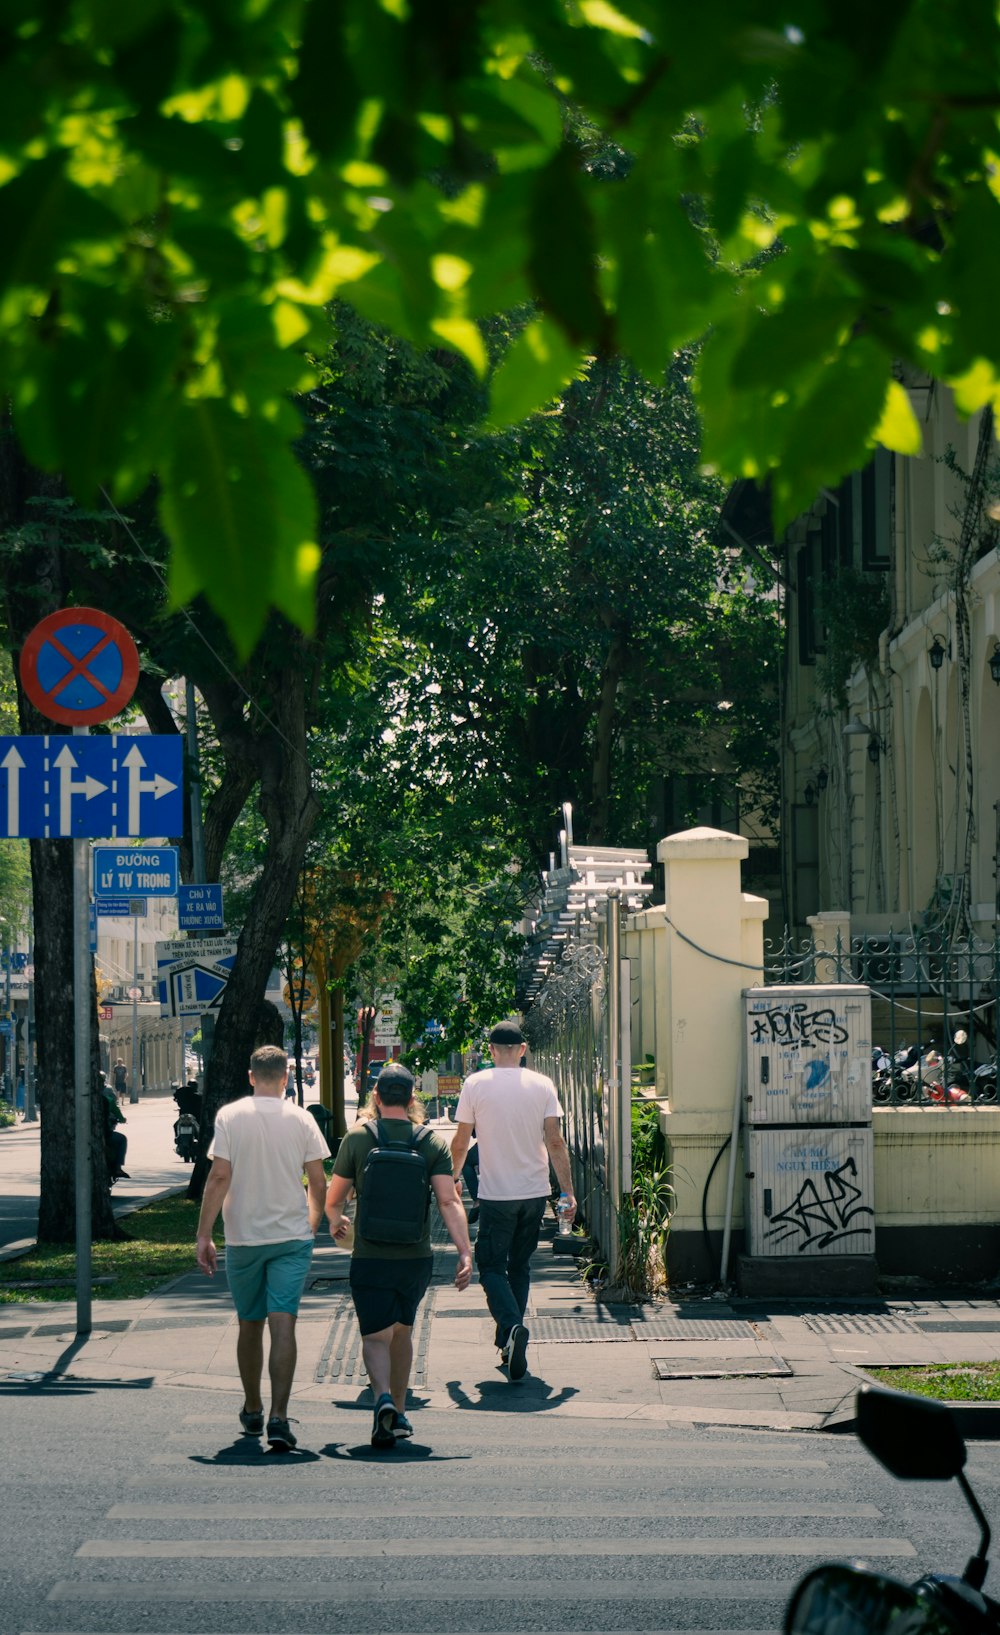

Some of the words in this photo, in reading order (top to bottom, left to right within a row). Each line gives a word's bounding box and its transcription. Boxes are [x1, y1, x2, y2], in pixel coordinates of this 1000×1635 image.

[116, 853, 160, 866] ĐƯỜNG
[101, 869, 114, 888] LÝ
[118, 870, 134, 891] TỰ
[136, 873, 171, 891] TRỌNG
[186, 903, 194, 912] XE
[196, 902, 204, 911] RA
[204, 939, 213, 947] TAXI
